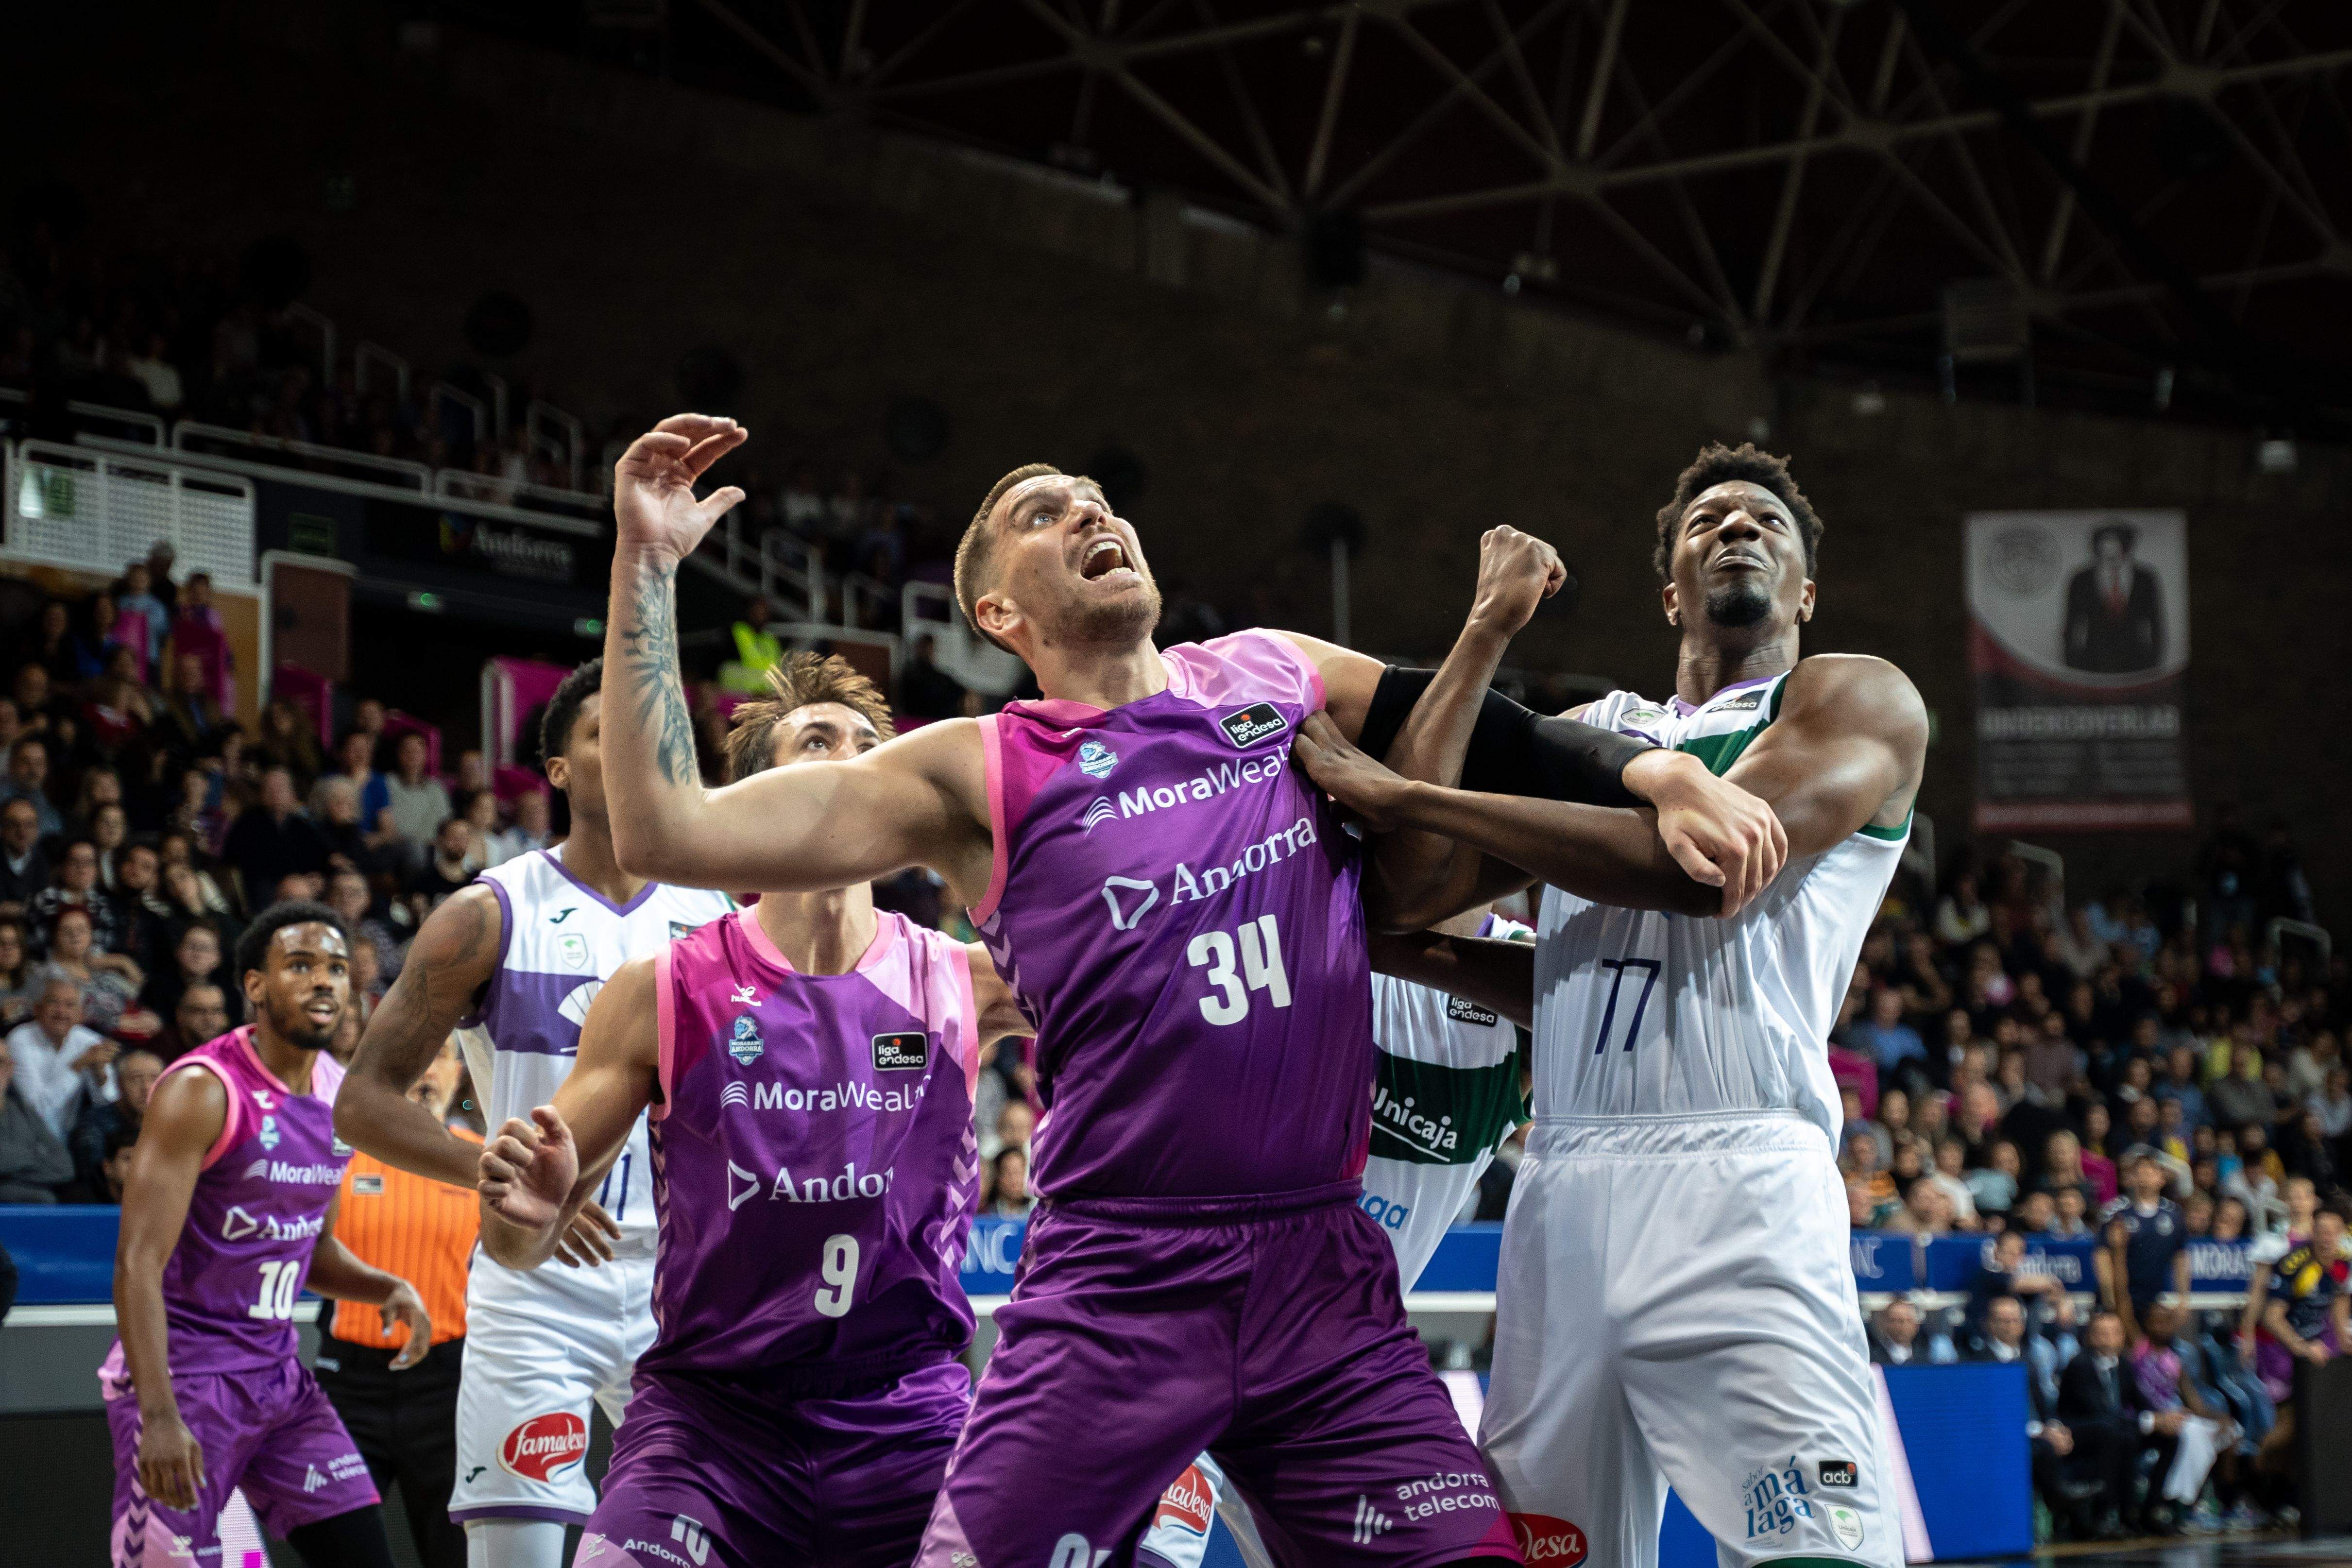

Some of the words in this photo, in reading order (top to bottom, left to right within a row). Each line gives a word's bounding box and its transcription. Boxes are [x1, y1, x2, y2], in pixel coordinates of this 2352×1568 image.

[1230, 721, 1253, 734] liga
[1238, 718, 1282, 741] endesa
[1187, 914, 1292, 1025] 34
[1449, 1008, 1495, 1023] endesa
[1451, 997, 1472, 1009] liga
[1595, 958, 1661, 1055] 77
[878, 1045, 899, 1056] liga
[879, 1054, 923, 1065] endesa
[814, 1234, 859, 1317] 9
[248, 1260, 300, 1320] 10
[1397, 1472, 1489, 1500] andorra
[1823, 1470, 1851, 1483] acb
[1404, 1494, 1500, 1521] telecom
[1746, 1497, 1816, 1538] laga
